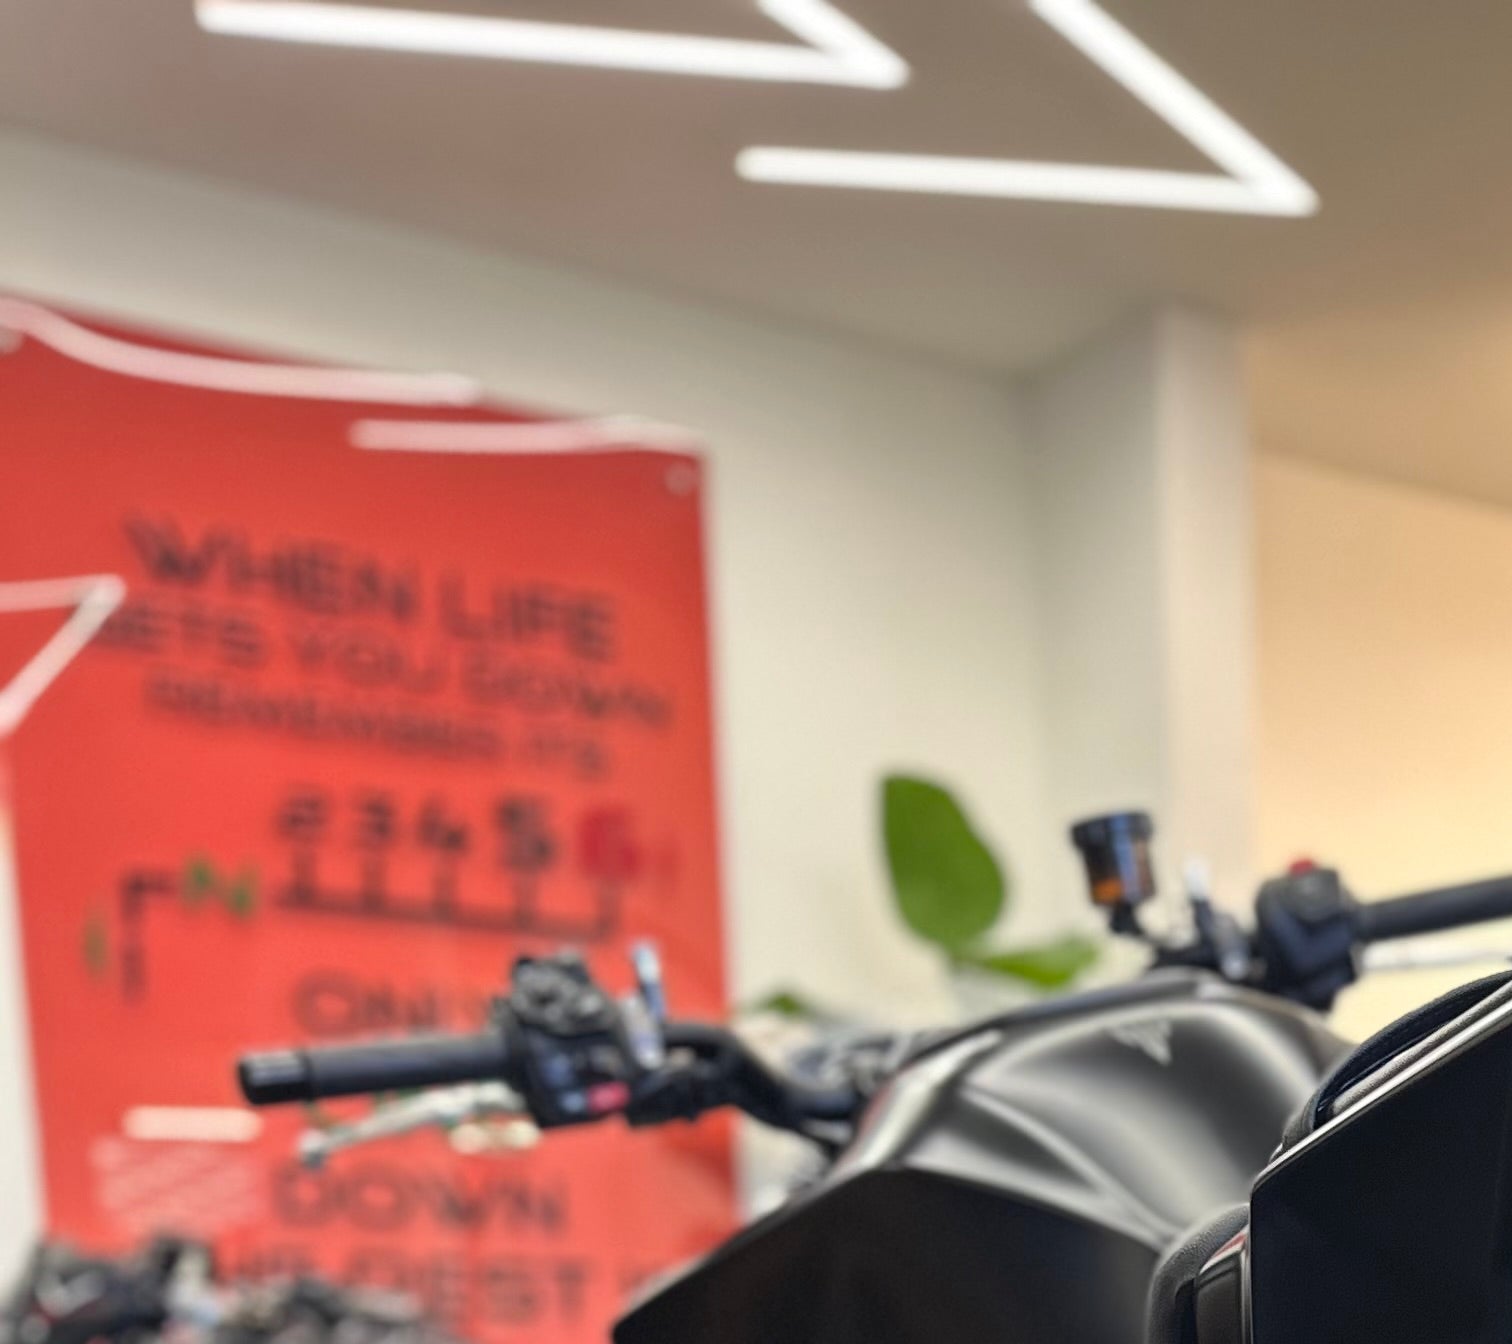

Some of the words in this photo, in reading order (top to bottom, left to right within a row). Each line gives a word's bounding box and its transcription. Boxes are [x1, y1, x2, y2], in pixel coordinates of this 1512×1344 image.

[121, 511, 420, 627] WHEN
[438, 568, 618, 662] LIFE
[290, 630, 449, 692] YOU
[460, 643, 675, 732] DOWN
[271, 1158, 567, 1240] DOWN
